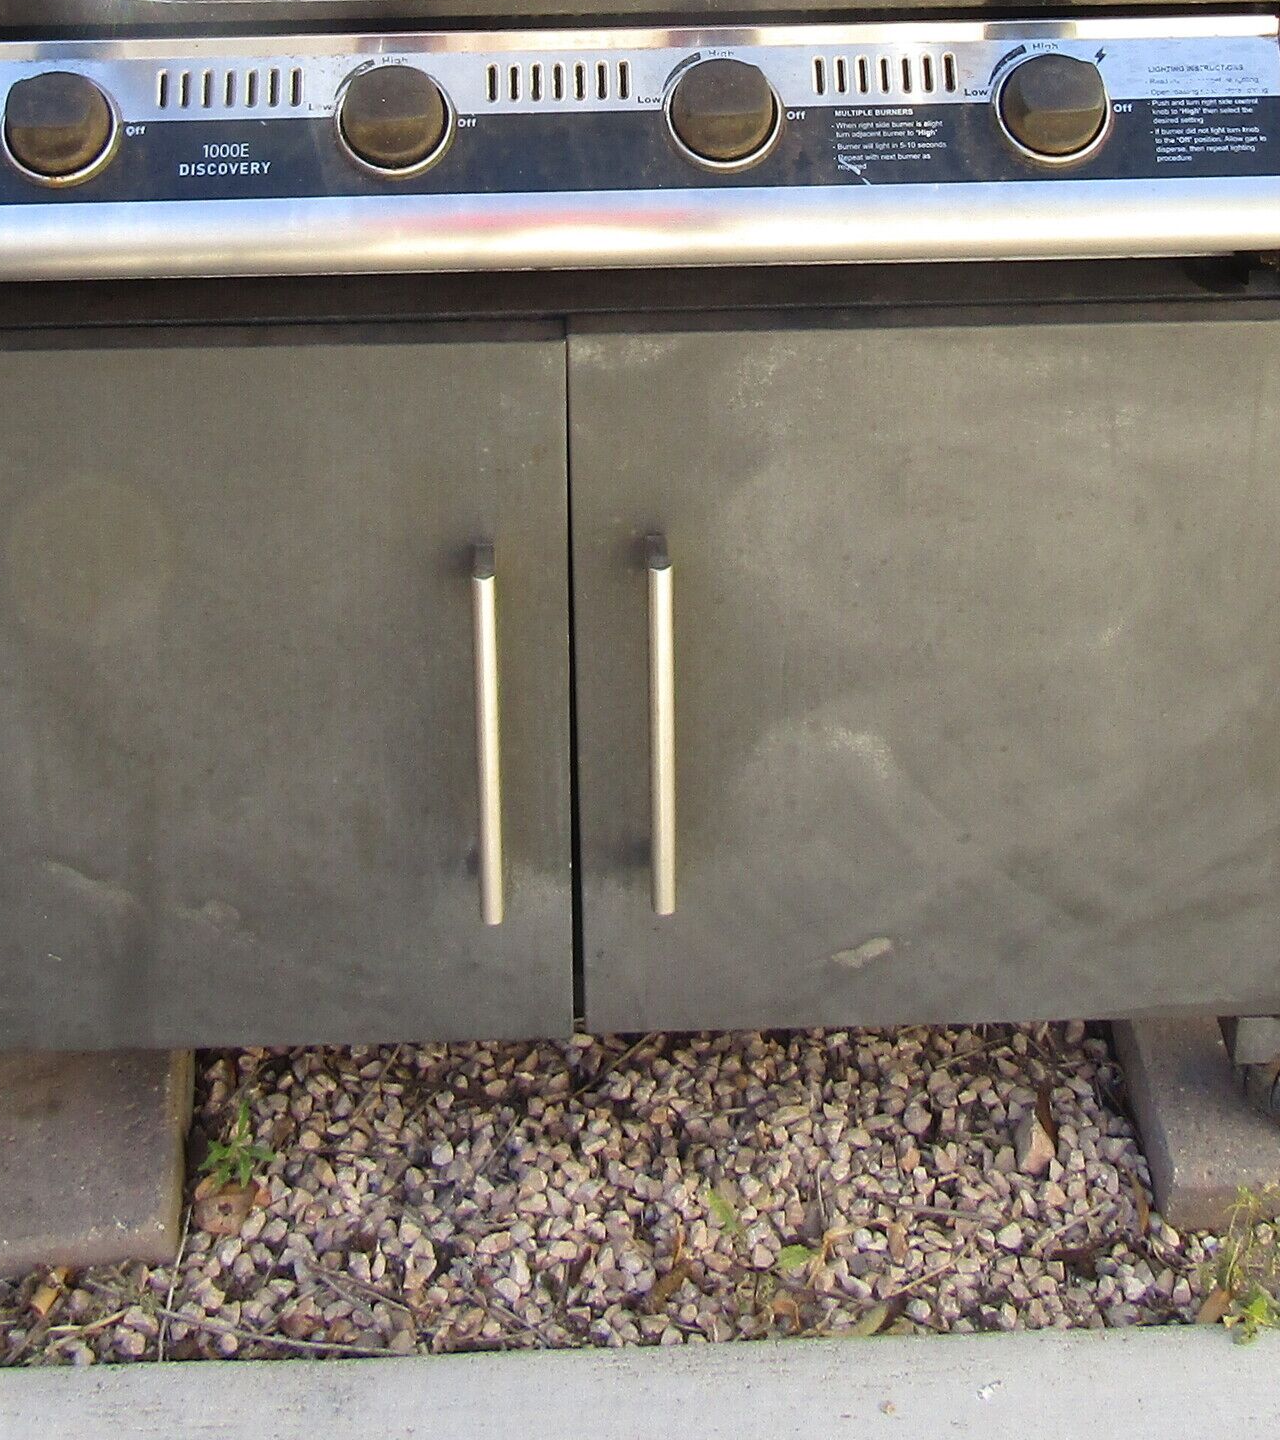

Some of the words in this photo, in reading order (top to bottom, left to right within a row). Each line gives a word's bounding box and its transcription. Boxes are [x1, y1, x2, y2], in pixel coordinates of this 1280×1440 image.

[1032, 43, 1059, 53] High
[708, 50, 735, 58] High
[382, 56, 409, 65] High
[964, 89, 989, 97] Low
[637, 95, 661, 104] Low
[308, 103, 333, 111] Lw
[1113, 103, 1133, 113] Off
[786, 111, 807, 121] Off
[834, 109, 873, 117] MULTIPLE
[874, 108, 914, 116] BURNERS
[457, 117, 477, 129] Off
[858, 122, 874, 130] right
[923, 120, 943, 129] alight
[125, 126, 146, 137] Off
[851, 130, 881, 139] adjacent
[1210, 127, 1226, 135] light
[203, 143, 250, 158] 1000E
[875, 142, 890, 151] light
[900, 141, 916, 149] 5-10
[1206, 145, 1229, 153] repeat
[1230, 145, 1256, 153] lighting
[837, 154, 863, 162] Repeat
[179, 162, 271, 176] DISCOVERY
